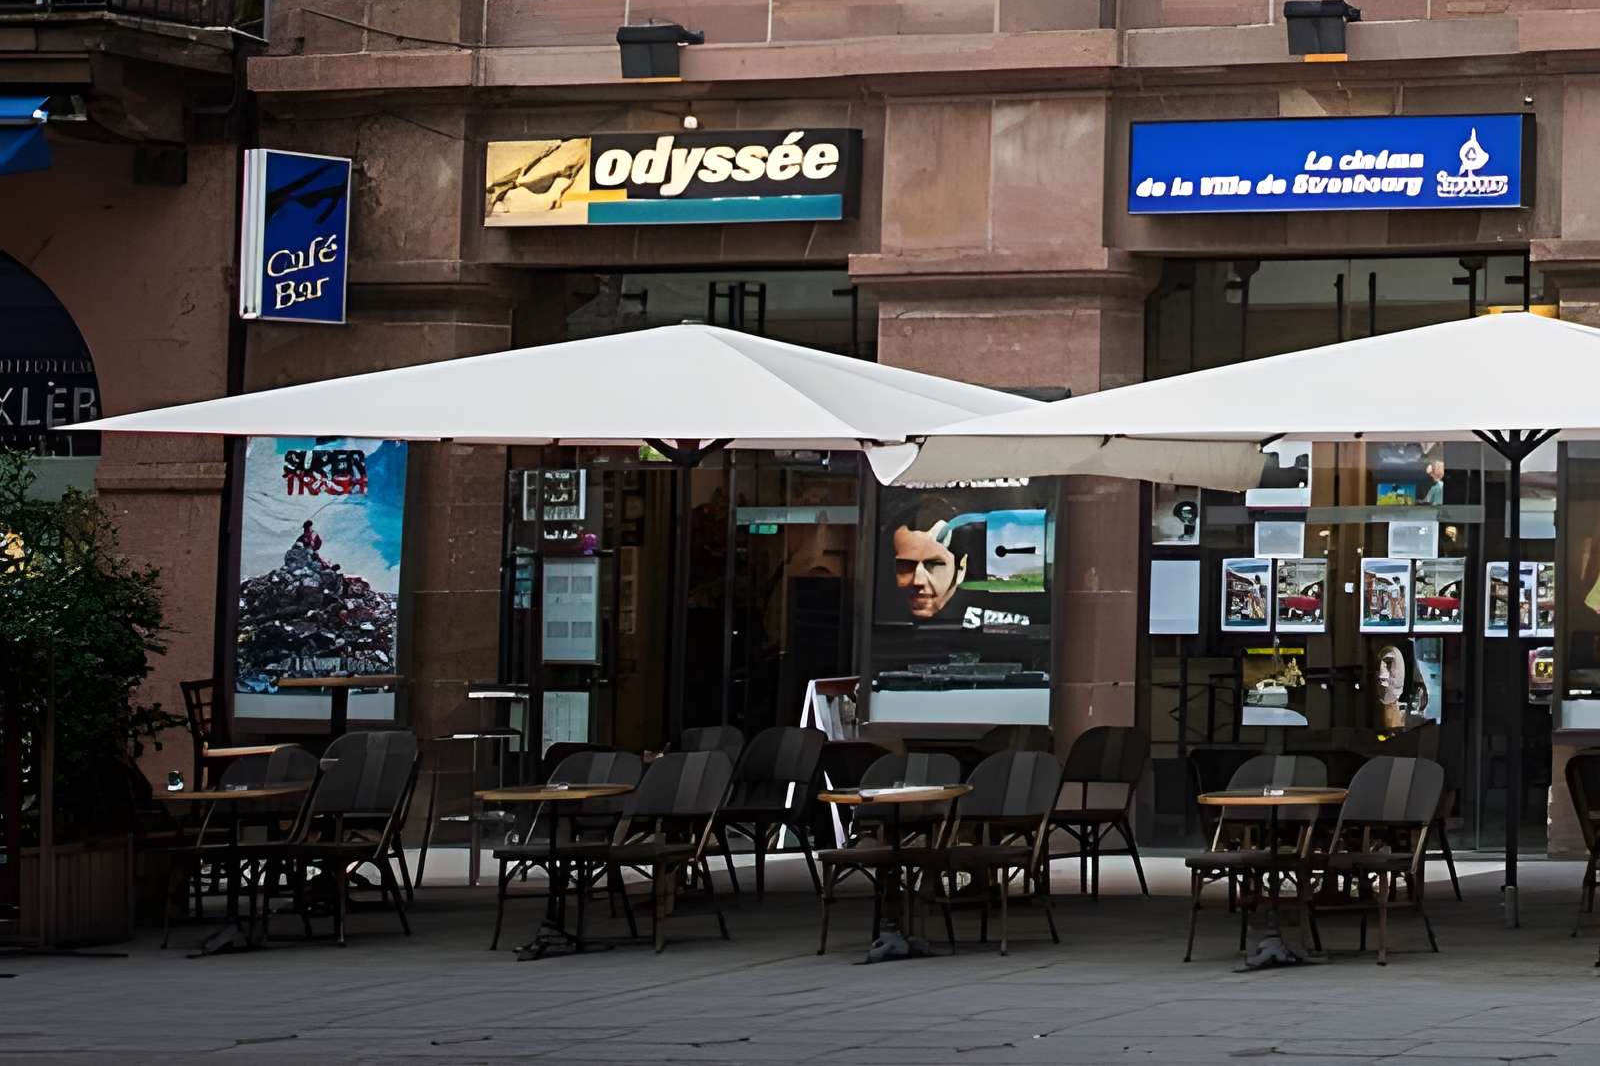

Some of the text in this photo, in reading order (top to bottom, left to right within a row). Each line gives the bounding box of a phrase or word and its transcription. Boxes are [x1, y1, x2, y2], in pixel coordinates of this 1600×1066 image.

[595, 131, 840, 196] odyssée
[267, 234, 339, 277] Café
[274, 277, 330, 309] Bar
[283, 450, 367, 479] SUPER
